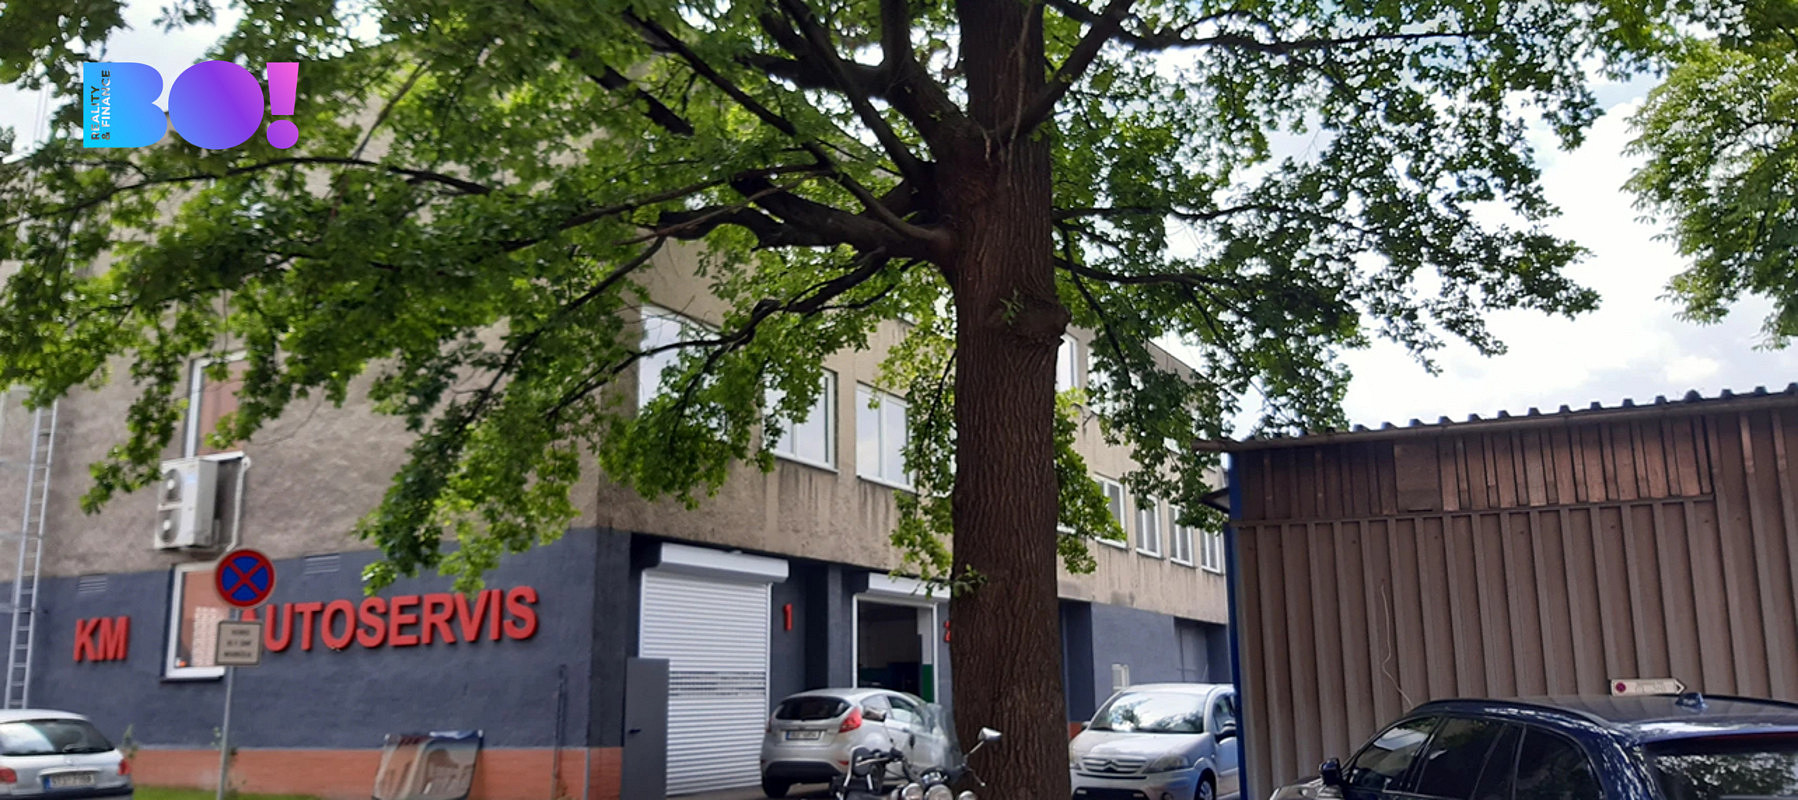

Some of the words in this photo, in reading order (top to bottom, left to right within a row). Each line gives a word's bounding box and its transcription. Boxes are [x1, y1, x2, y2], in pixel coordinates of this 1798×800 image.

[73, 615, 130, 662] KM
[240, 586, 537, 651] UTOSERVIS
[783, 603, 793, 631] 1
